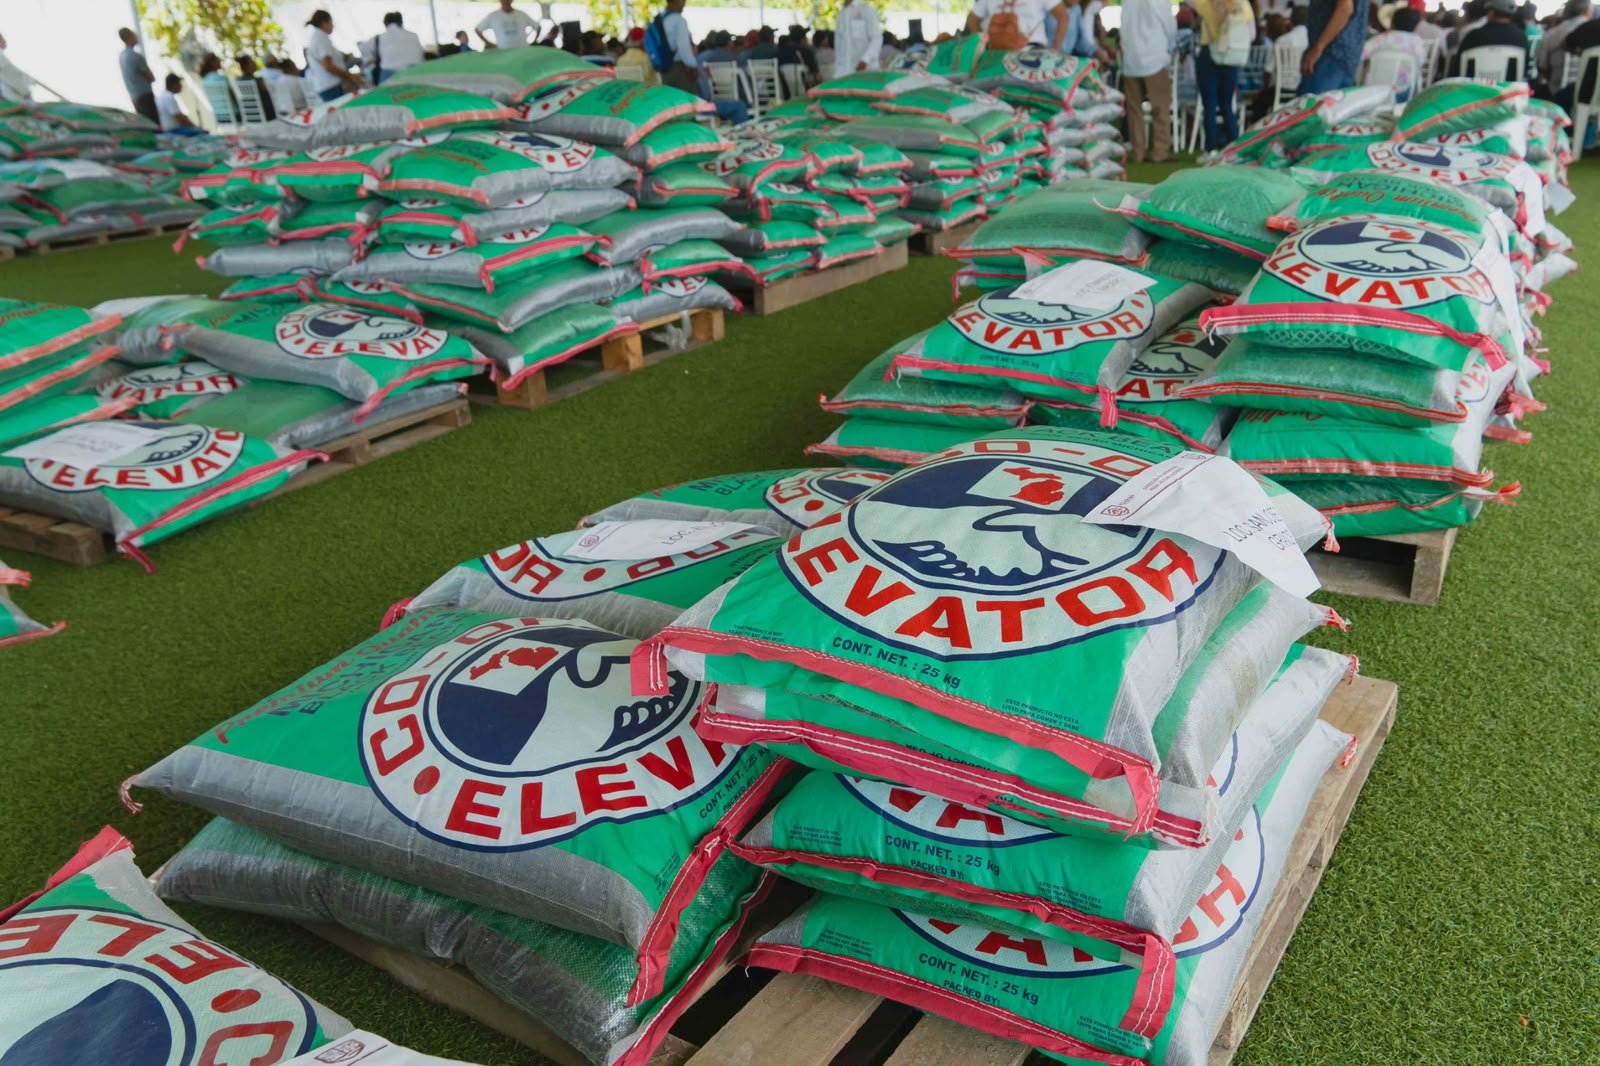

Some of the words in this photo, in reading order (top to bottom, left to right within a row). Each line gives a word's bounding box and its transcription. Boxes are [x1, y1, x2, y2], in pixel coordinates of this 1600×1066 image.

[833, 636, 872, 657] CONT.
[877, 647, 909, 669] NET.
[921, 663, 941, 678] 25
[943, 673, 961, 689] kg
[699, 790, 726, 820] CONT.
[724, 769, 744, 793] NET.
[885, 834, 921, 853] CONT.
[925, 843, 953, 861] NET.
[965, 854, 982, 868] 25
[986, 860, 1000, 877] kg
[910, 859, 948, 875] PACKED
[950, 870, 965, 881] BY:
[918, 953, 956, 975] CONT.
[961, 966, 990, 986] NET.
[1002, 981, 1019, 996] 25
[1022, 988, 1040, 1006] kg
[943, 979, 982, 999] PACKED
